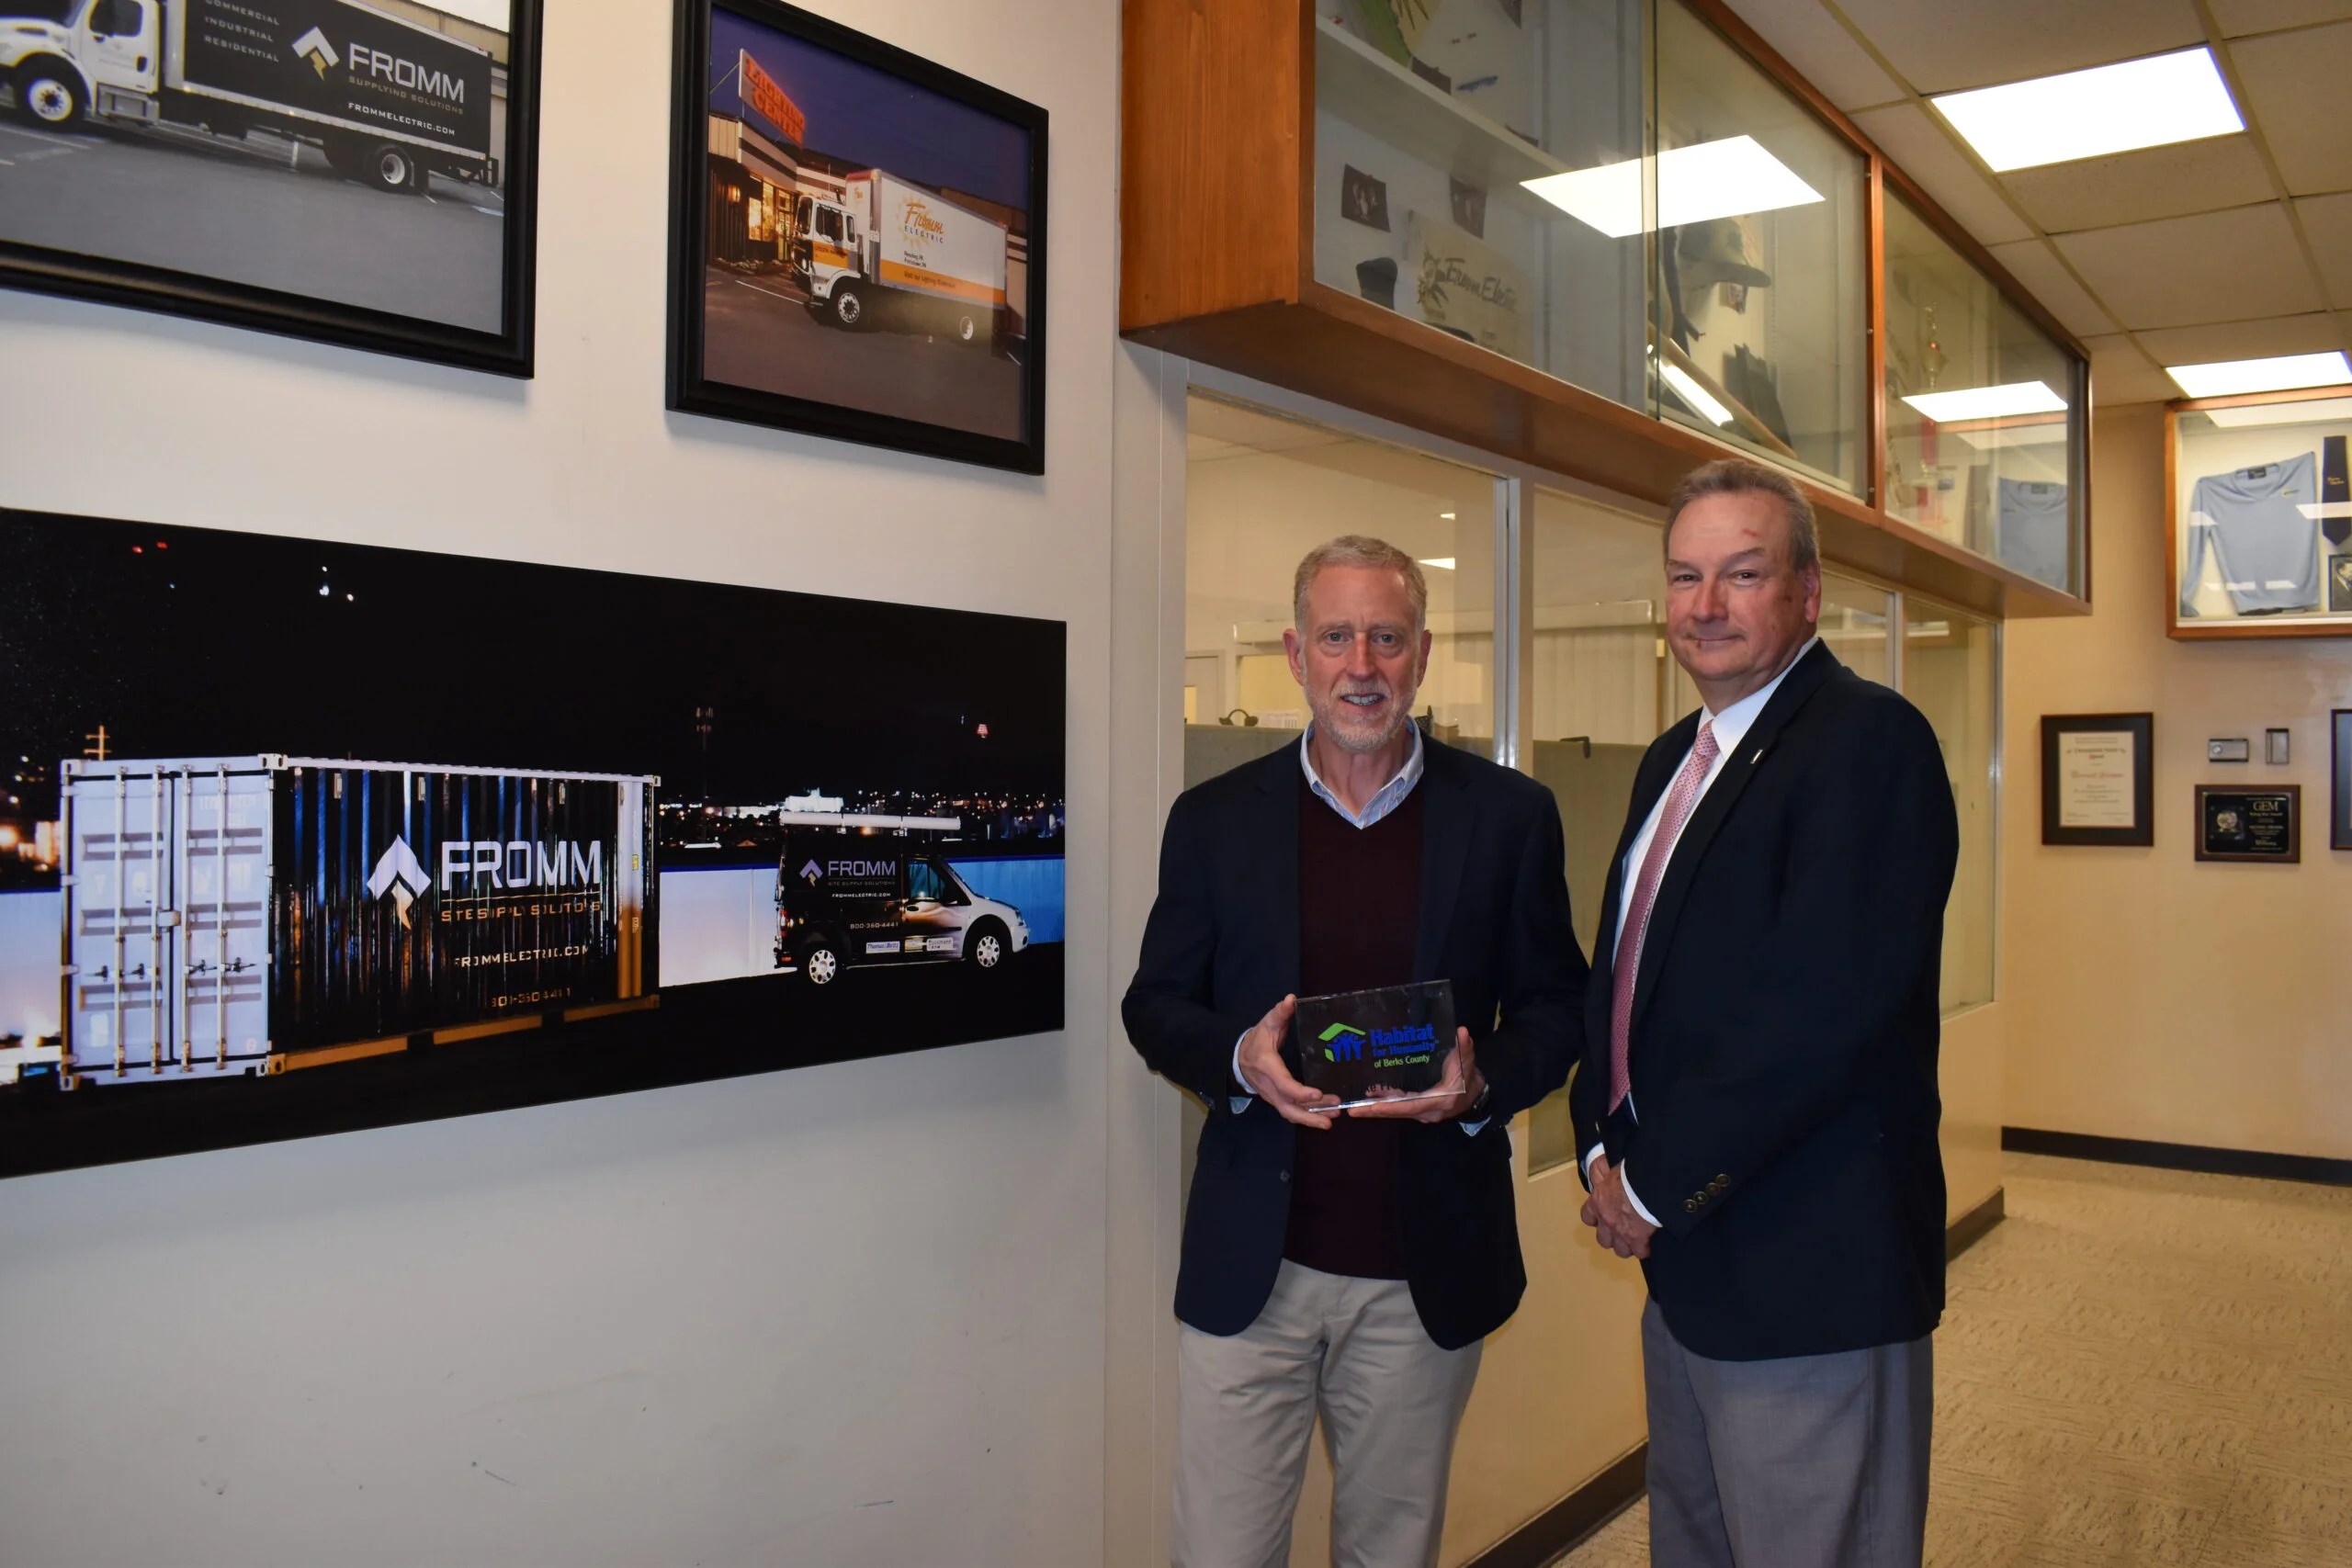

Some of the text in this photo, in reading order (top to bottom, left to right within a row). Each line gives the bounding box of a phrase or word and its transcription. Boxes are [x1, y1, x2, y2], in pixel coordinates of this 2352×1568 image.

[204, 16, 274, 42] INDUSTRIAL
[204, 35, 279, 62] RESIDENTIAL
[349, 42, 464, 104] FROMM
[349, 75, 463, 115] SUPPLYING SOLUTIONS
[348, 102, 456, 136] FROMMELECTRIC.COM
[752, 89, 804, 147] CENTER
[905, 225, 944, 243] ELECTRIC
[2253, 801, 2278, 811] GEM
[442, 840, 601, 891] FROMM
[828, 861, 896, 876] FROMM
[1370, 1023, 1433, 1046] Habitat
[1373, 1048, 1385, 1057] for
[1384, 1057, 1404, 1067] Berks
[1405, 1054, 1430, 1064] County
